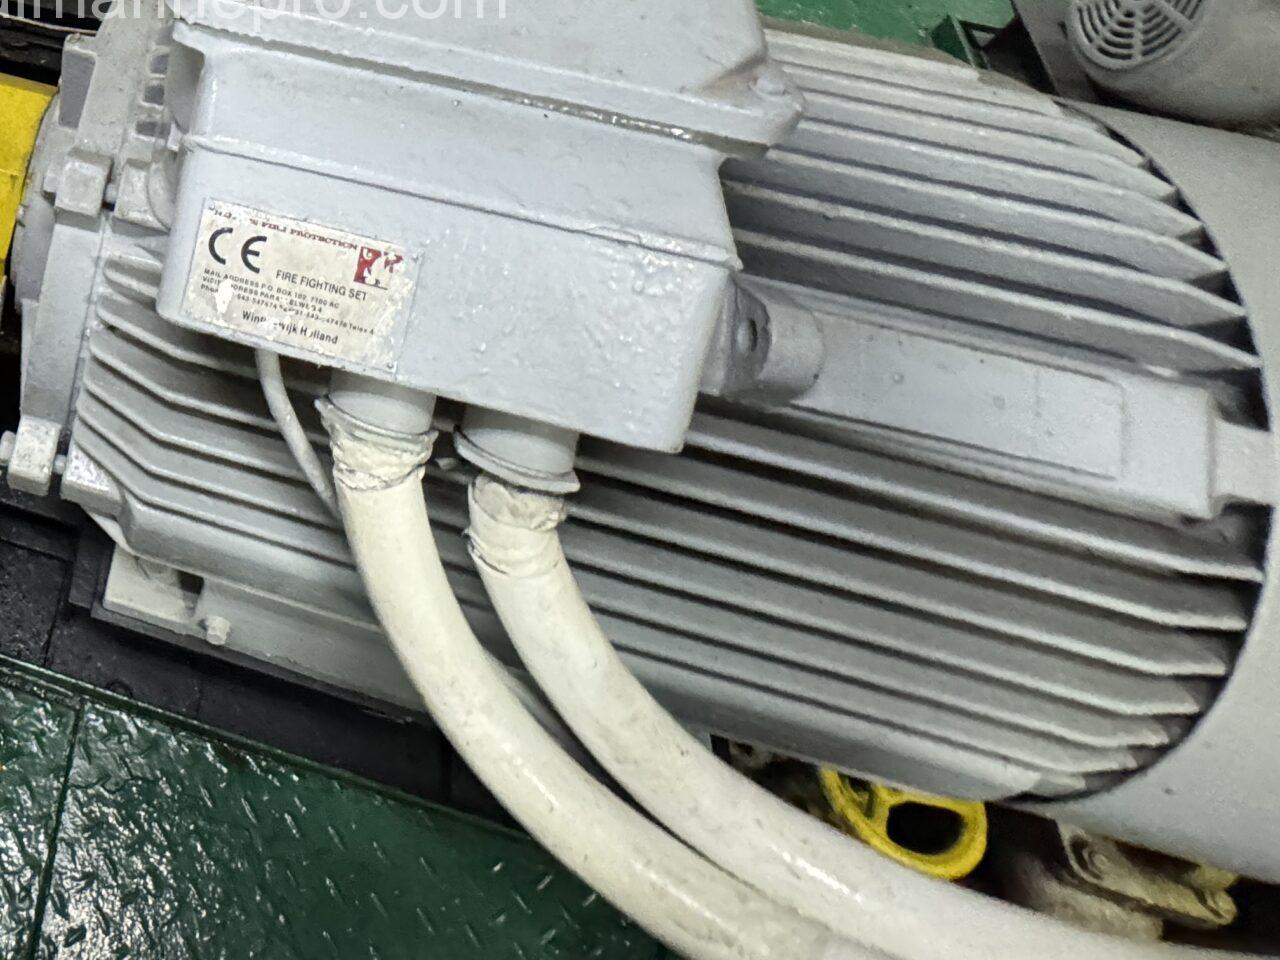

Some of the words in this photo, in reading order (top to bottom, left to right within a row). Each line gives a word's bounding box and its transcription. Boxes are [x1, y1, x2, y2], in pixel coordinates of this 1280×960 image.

[208, 227, 267, 274] CE
[204, 268, 221, 279] MAIL
[276, 288, 292, 297] BOX
[275, 269, 298, 285] FIRE
[300, 275, 347, 297] FIGHTING
[348, 288, 367, 302] SET
